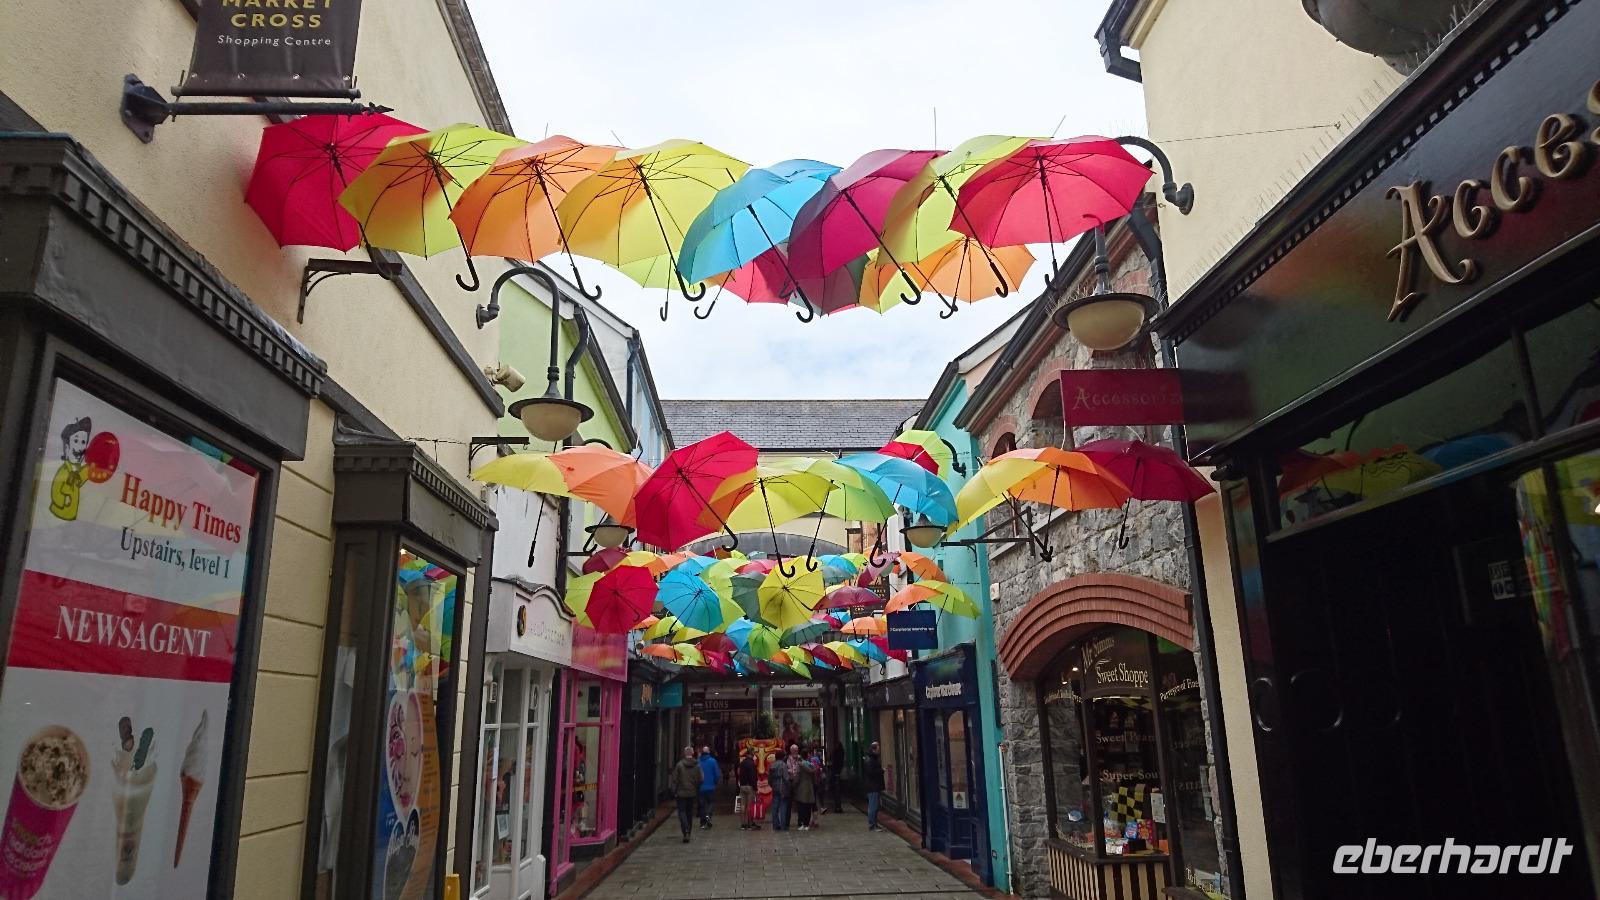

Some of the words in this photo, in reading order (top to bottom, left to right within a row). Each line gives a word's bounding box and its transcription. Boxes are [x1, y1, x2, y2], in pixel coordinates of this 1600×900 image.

[222, 0, 332, 8] MARKET
[230, 13, 321, 28] CROSS
[217, 34, 280, 47] Shopping
[284, 35, 331, 46] Centre
[120, 472, 187, 531] Happy
[192, 501, 242, 544] Times
[120, 526, 186, 571] Upstairs,
[189, 548, 220, 576] level
[223, 559, 230, 579] 1
[53, 605, 212, 657] NEWSAGENT
[1096, 666, 1118, 684] Sweet
[1118, 662, 1149, 688] Shoppe
[1103, 769, 1134, 783] Super
